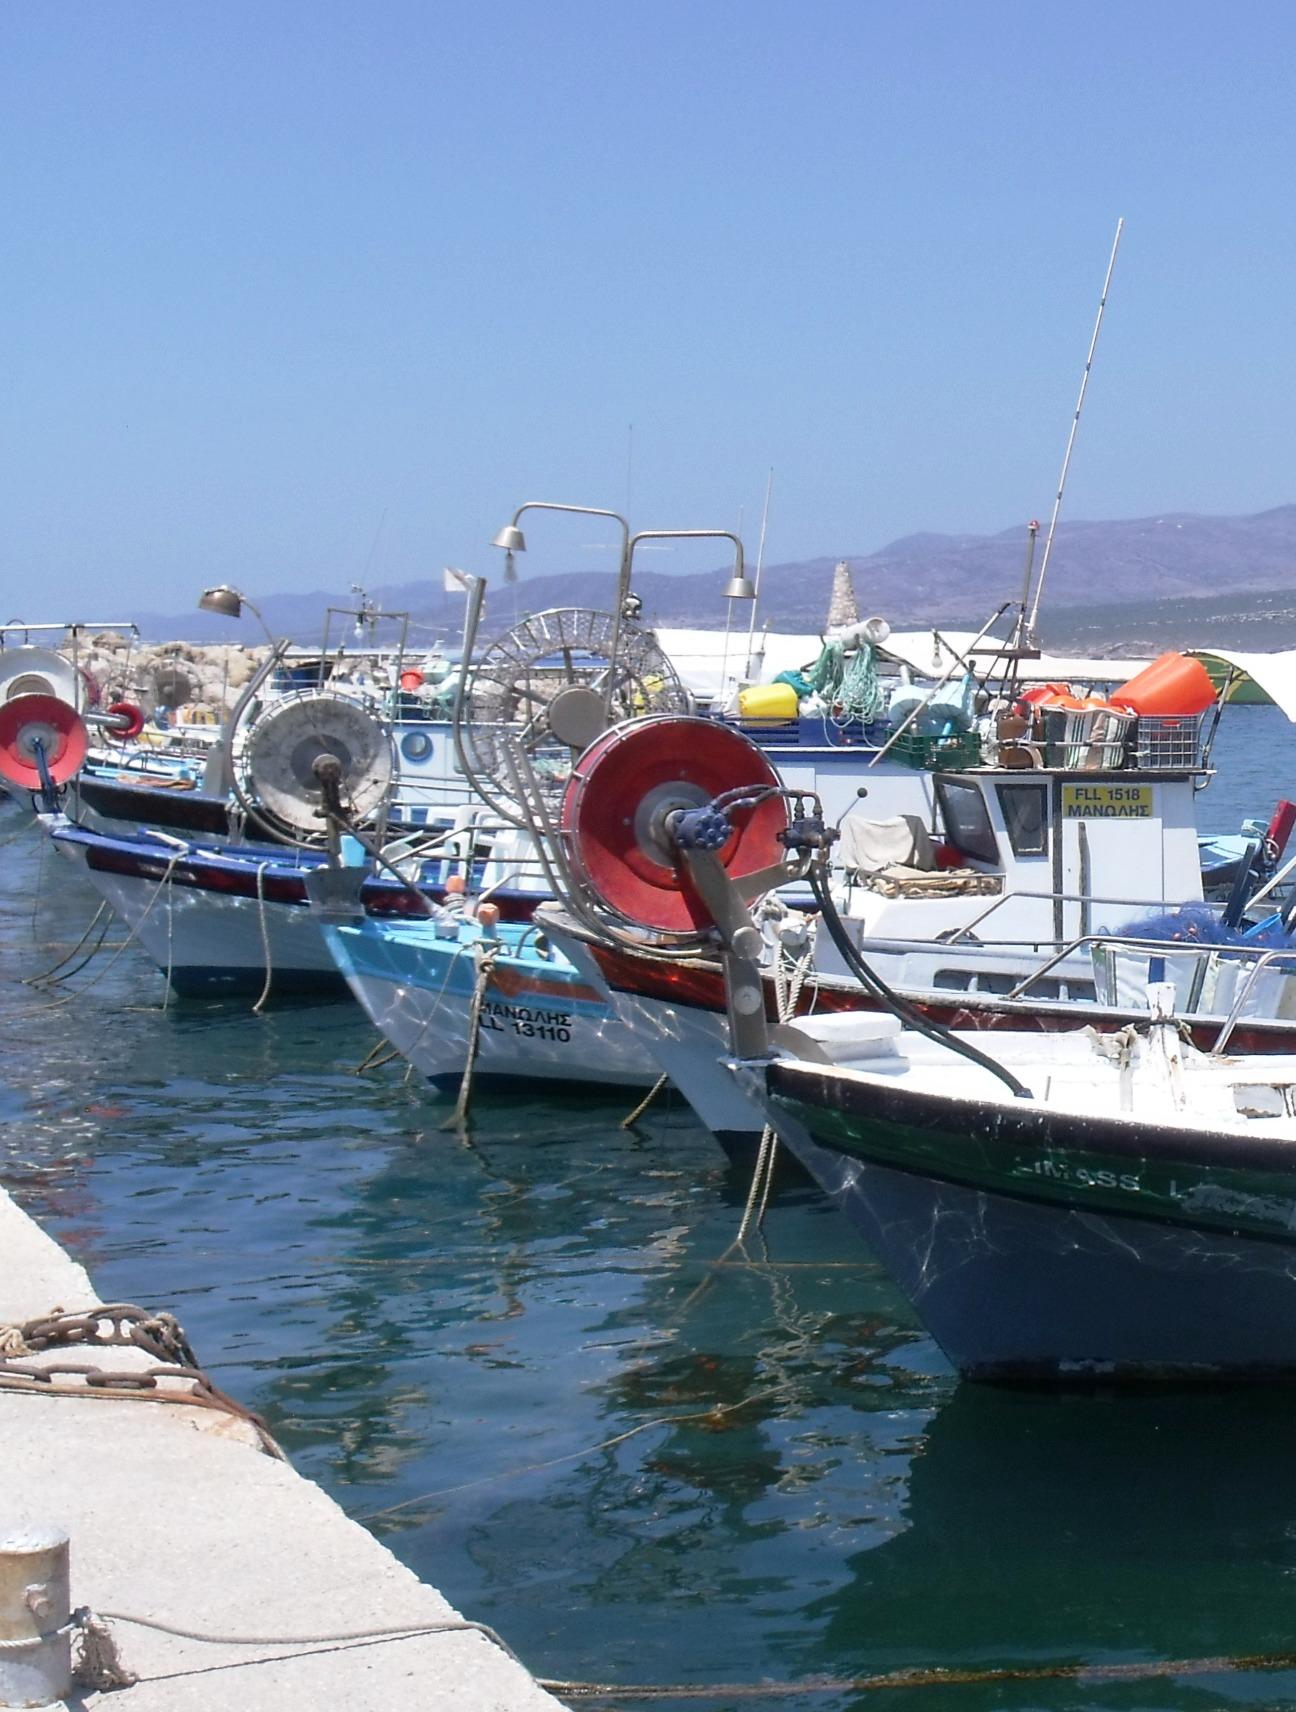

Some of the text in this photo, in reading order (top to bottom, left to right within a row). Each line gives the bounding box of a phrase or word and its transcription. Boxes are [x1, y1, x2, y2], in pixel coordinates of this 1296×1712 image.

[1075, 788, 1140, 801] FLL 1518
[1068, 805, 1149, 817] ΜΑΝΩΛΗΣ
[512, 1022, 571, 1042] 13110
